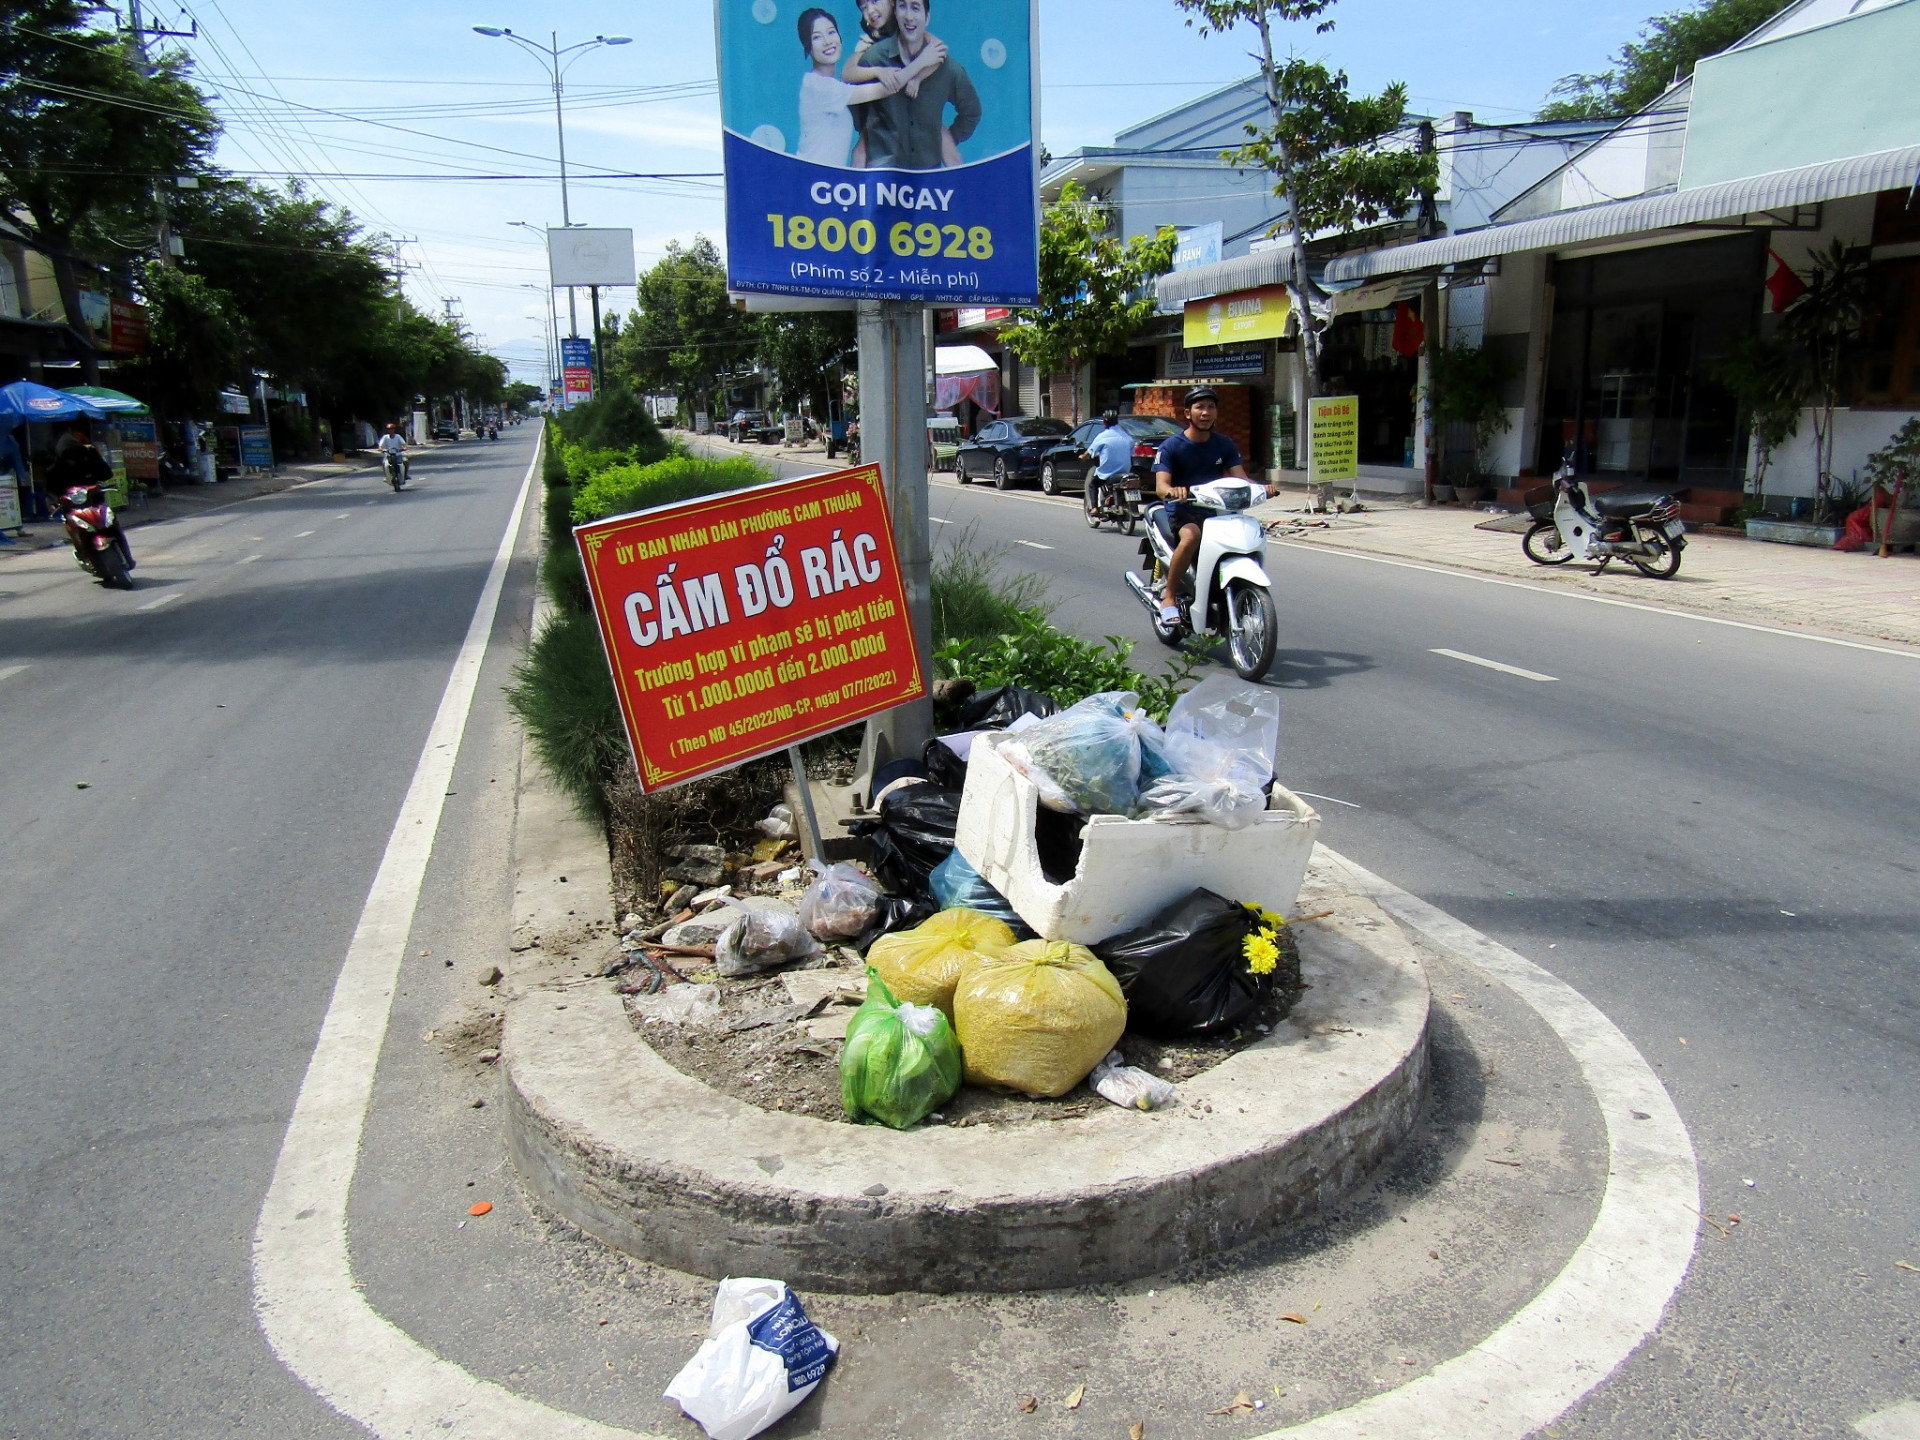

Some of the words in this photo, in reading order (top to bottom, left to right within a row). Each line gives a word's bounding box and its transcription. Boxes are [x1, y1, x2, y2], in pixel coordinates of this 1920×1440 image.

[810, 181, 866, 212] GỌI
[876, 182, 954, 212] NGAY
[767, 213, 877, 255] 1800
[889, 220, 994, 260] 6928
[1172, 253, 1181, 265] AM
[1182, 247, 1202, 263] RANH
[757, 282, 769, 290] CTY
[771, 283, 789, 292] TNHH
[790, 261, 845, 280] (Phím
[850, 263, 869, 283] số
[873, 269, 884, 283] 2
[900, 268, 943, 285] Miễn
[947, 271, 979, 289] phí)
[1228, 297, 1262, 319] BIVINA
[638, 533, 668, 560] BAN
[670, 521, 709, 551] NHÂN
[710, 517, 739, 544] DÂN
[741, 505, 792, 535] PHƯỜNG
[793, 500, 822, 523] CAM
[822, 489, 862, 517] THUẬN
[623, 562, 731, 648] CẤM
[734, 533, 796, 619] ĐỔ
[800, 528, 882, 600] RÁC
[634, 655, 694, 692] Trường
[695, 649, 729, 679] hợp
[730, 640, 747, 664] vi
[749, 629, 793, 661] phạm
[794, 620, 814, 643] sẽ
[815, 613, 833, 640] bị
[834, 605, 867, 639] phạt
[867, 593, 896, 624] tiền
[661, 690, 685, 721] Từ
[686, 669, 775, 713] 1.000.000đ
[776, 653, 807, 684] đến
[809, 631, 888, 675] 2.000.000đ
[677, 733, 708, 755] Theo
[709, 724, 727, 743] NĐ
[728, 697, 815, 736] 45/2022/NĐ-CP,
[815, 689, 841, 714] ngày
[806, 1363, 827, 1380] 6928
